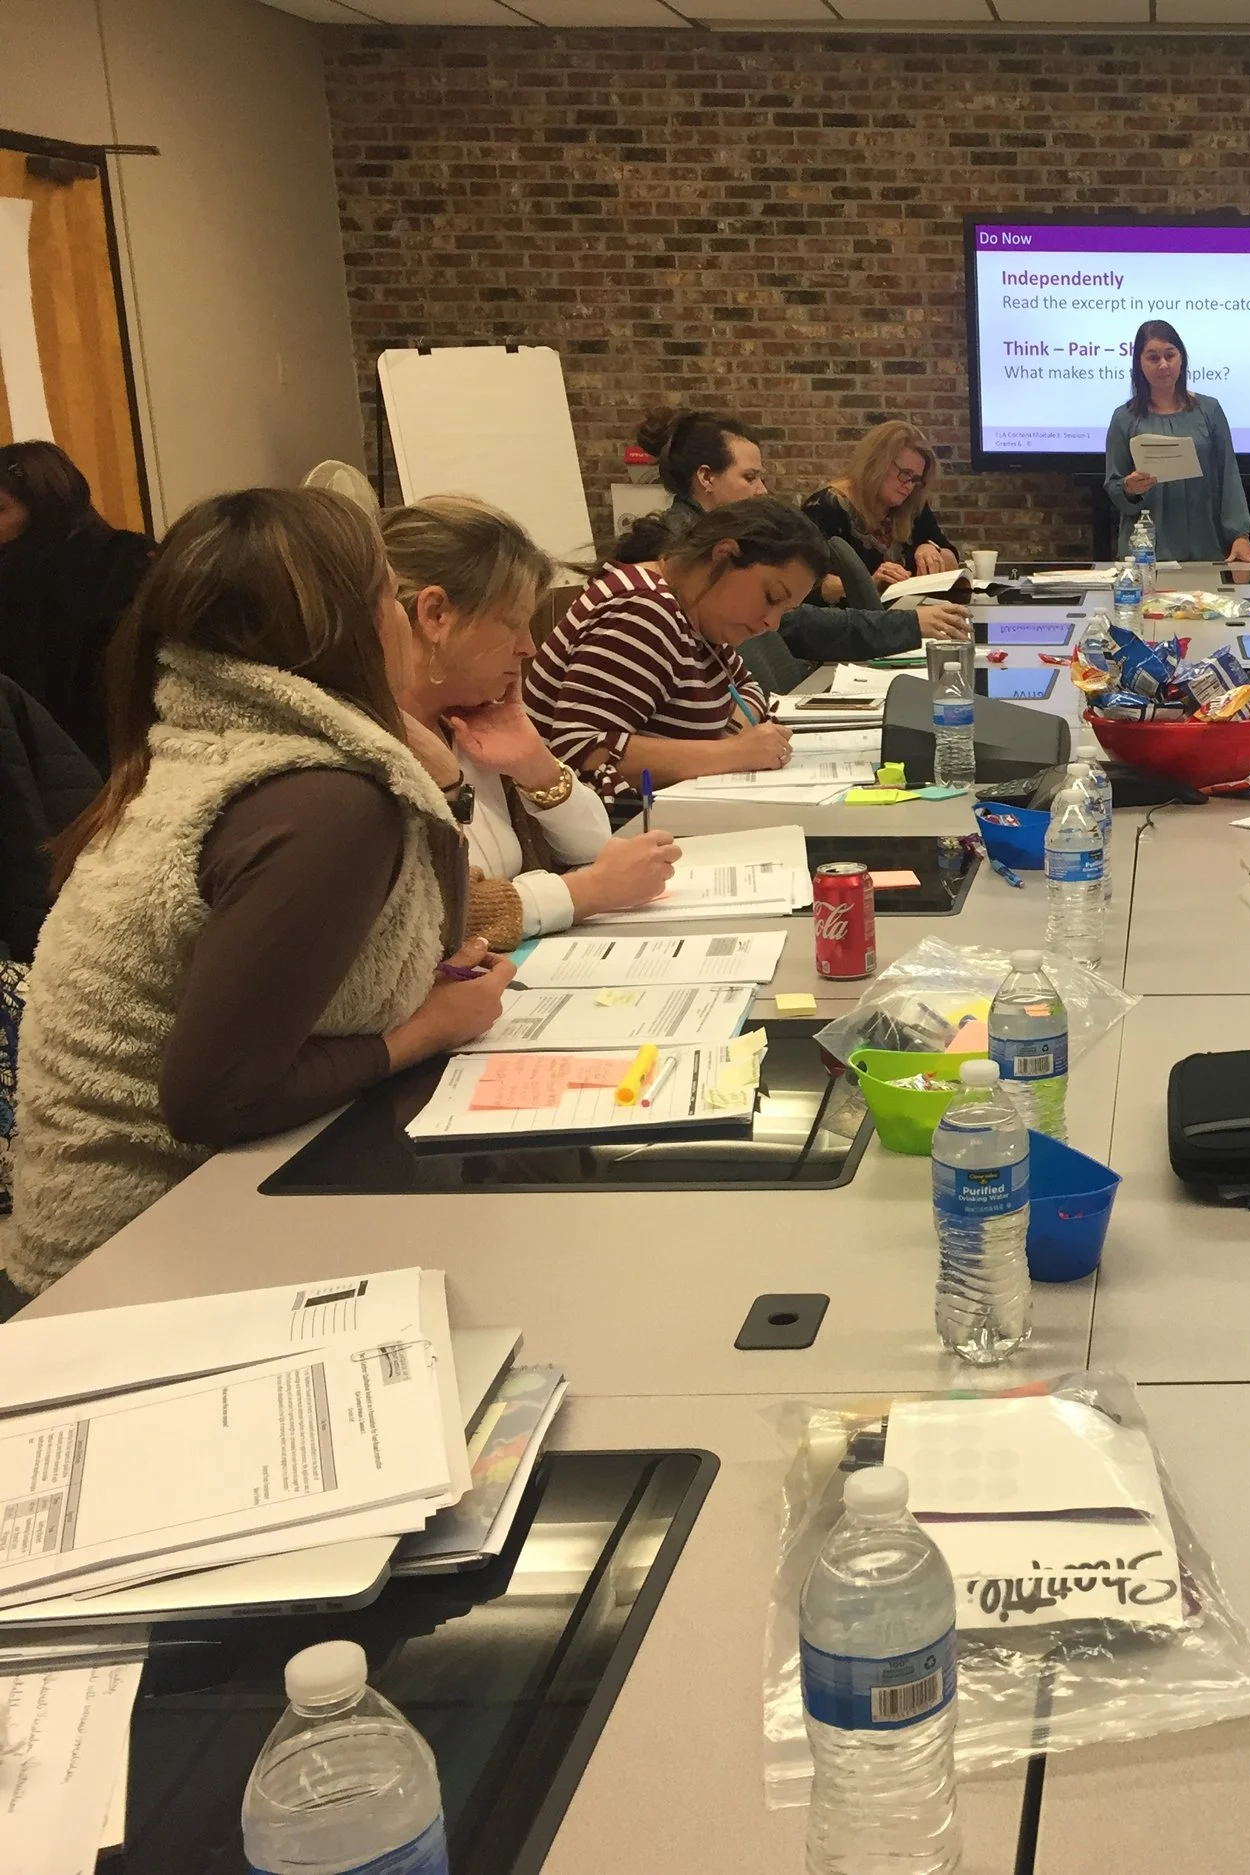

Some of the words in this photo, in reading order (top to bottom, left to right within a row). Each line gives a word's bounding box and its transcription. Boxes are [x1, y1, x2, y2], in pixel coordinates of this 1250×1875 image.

[979, 231, 998, 245] Do
[1001, 232, 1033, 245] Now
[1001, 270, 1124, 290] Independently
[1002, 295, 1039, 309] Read
[1043, 296, 1067, 309] the
[1071, 298, 1126, 312] excerpt
[1130, 296, 1144, 310] in
[1147, 298, 1181, 313] your
[1003, 341, 1049, 356] Think
[1068, 342, 1101, 356] Pair
[1004, 365, 1044, 379] What
[1048, 365, 1095, 380] makes
[1098, 366, 1125, 380] this
[962, 1184, 1005, 1195] Purified
[989, 1193, 1009, 1201] Water
